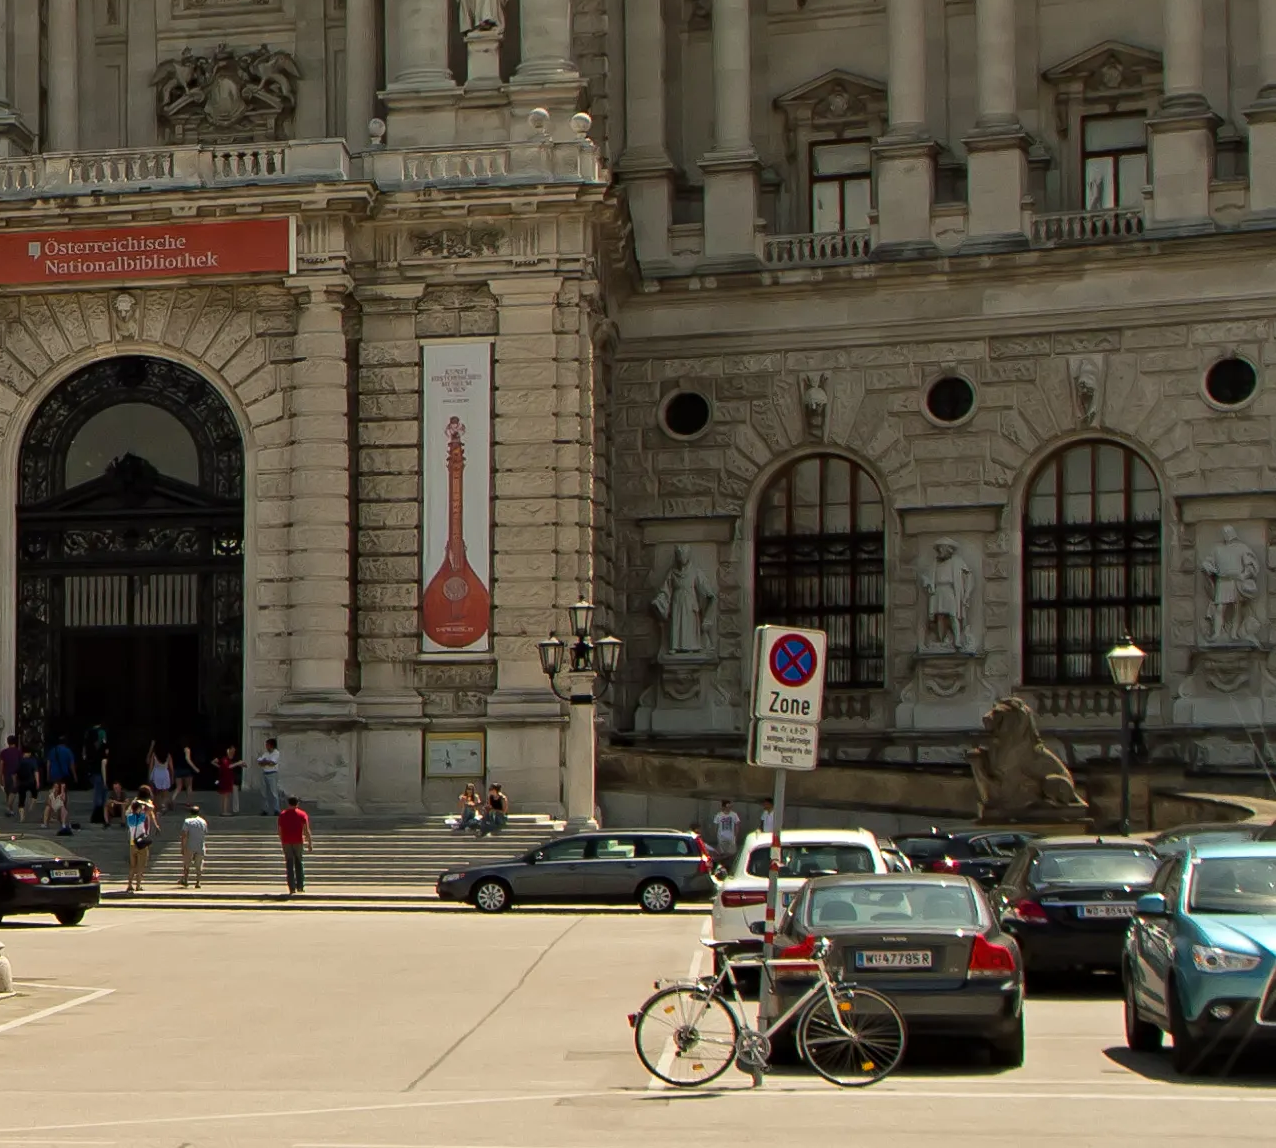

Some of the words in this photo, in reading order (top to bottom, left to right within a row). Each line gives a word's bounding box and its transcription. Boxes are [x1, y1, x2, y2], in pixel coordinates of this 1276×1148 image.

[44, 234, 187, 256] Österreichische
[45, 251, 219, 275] Nationalbibliothek
[769, 691, 811, 715] Zone
